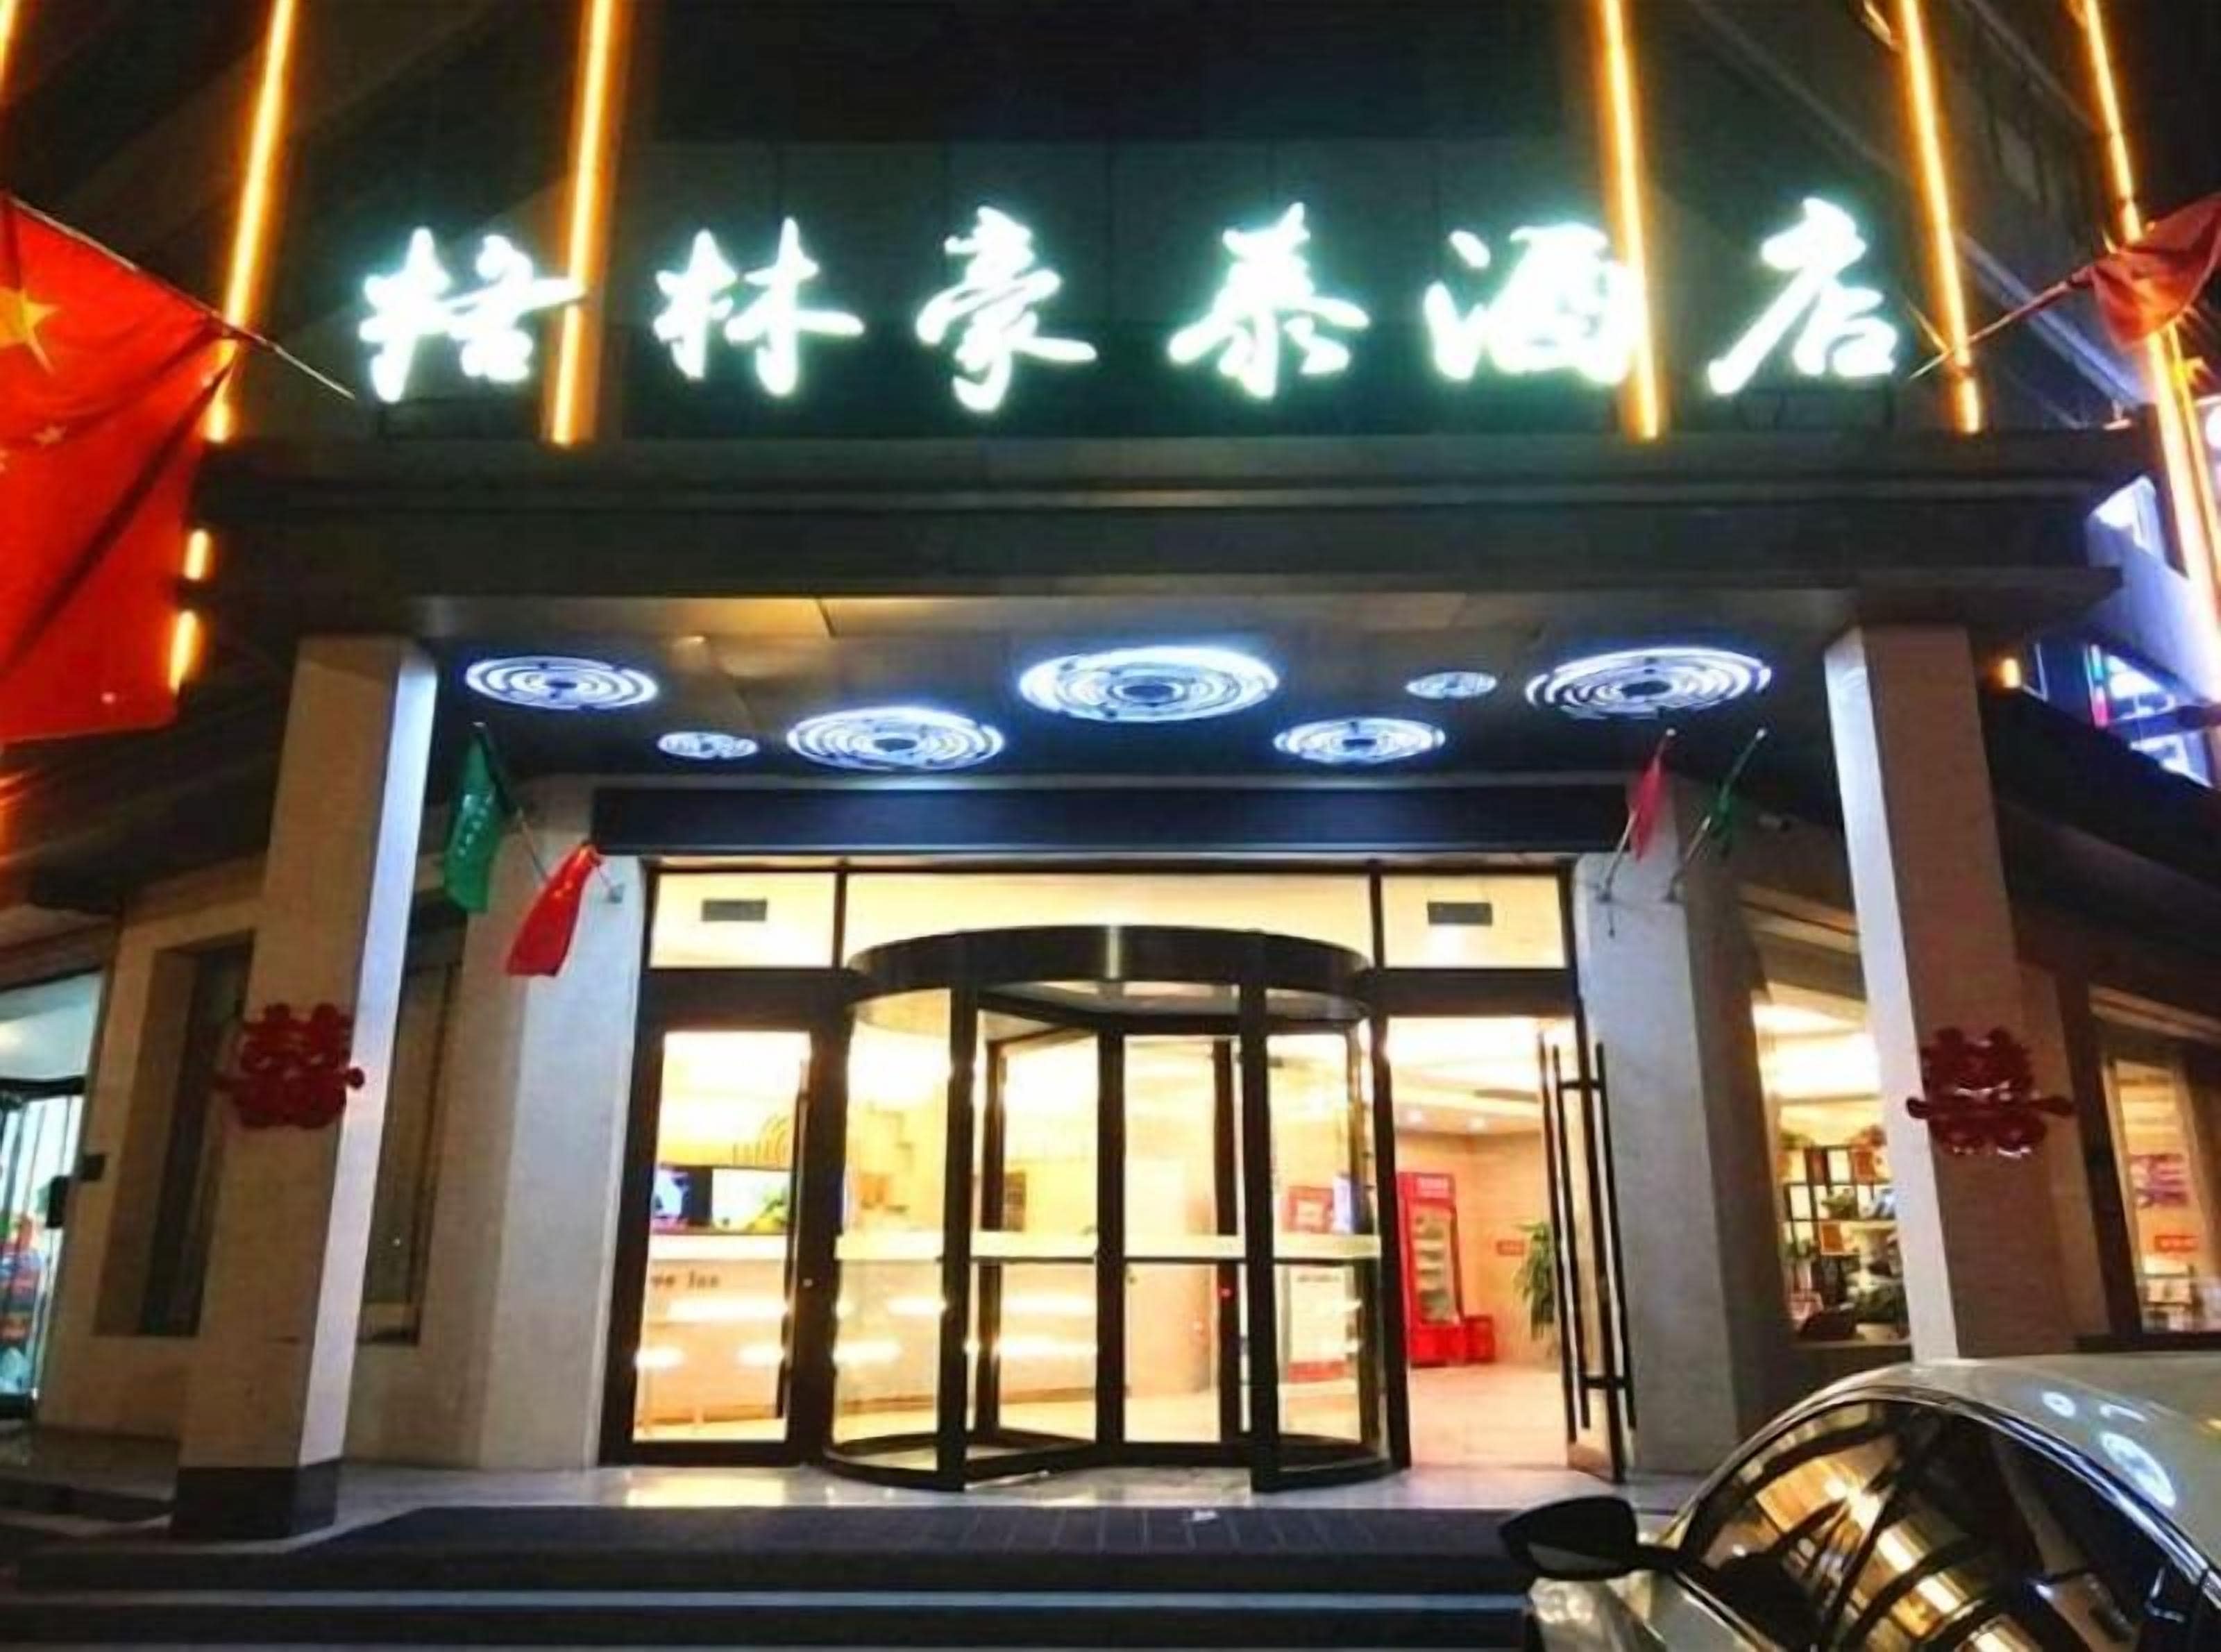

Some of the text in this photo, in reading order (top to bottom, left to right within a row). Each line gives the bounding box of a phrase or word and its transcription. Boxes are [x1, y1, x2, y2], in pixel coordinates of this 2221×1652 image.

[358, 199, 1898, 411] 格林豪泰酒店
